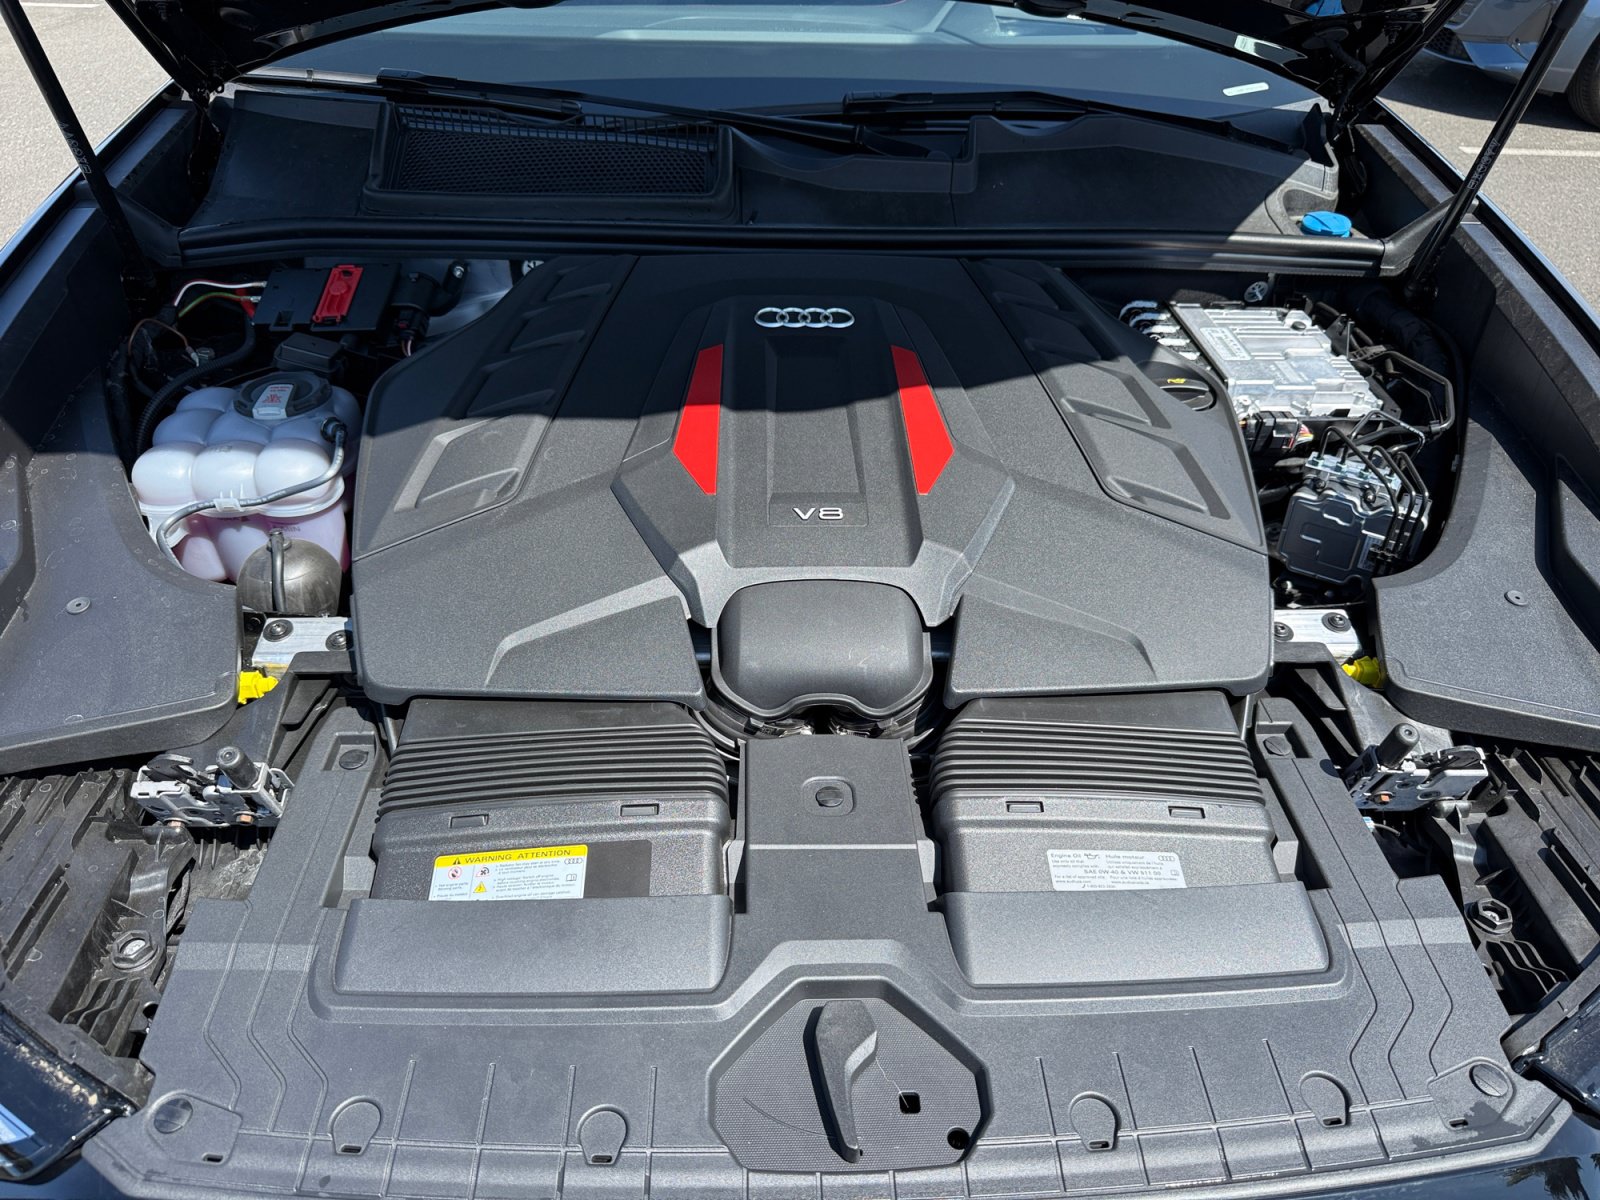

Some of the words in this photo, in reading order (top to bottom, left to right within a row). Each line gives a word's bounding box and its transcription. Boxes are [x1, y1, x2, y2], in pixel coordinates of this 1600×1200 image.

[792, 507, 844, 520] V8
[465, 853, 512, 864] WARNING
[517, 849, 571, 859] ATTENTION
